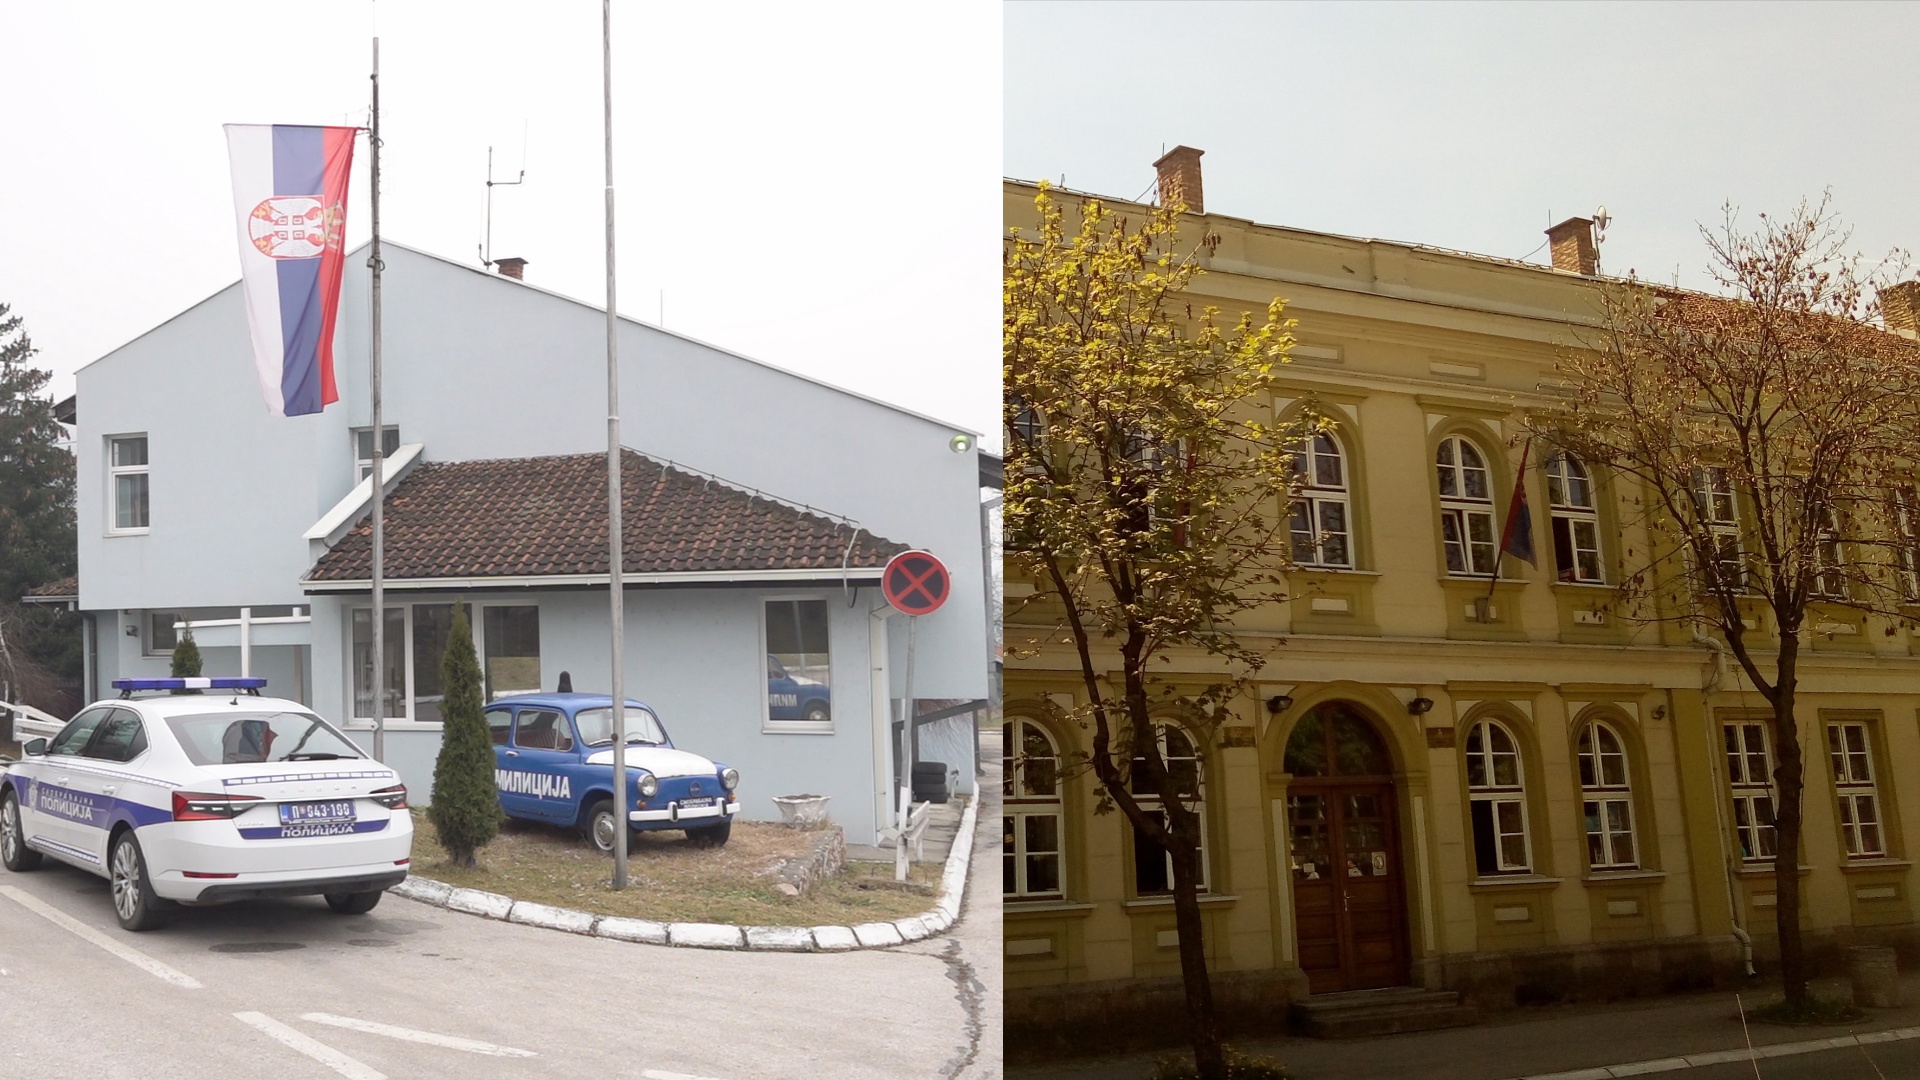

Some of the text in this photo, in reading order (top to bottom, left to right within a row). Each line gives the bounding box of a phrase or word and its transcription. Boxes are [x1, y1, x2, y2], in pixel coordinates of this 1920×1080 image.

[495, 769, 571, 799] МИЛИЦИЈА
[41, 795, 94, 821] ПОЛИЦИЈА
[281, 826, 354, 838] ПОЛИЦИЈА
